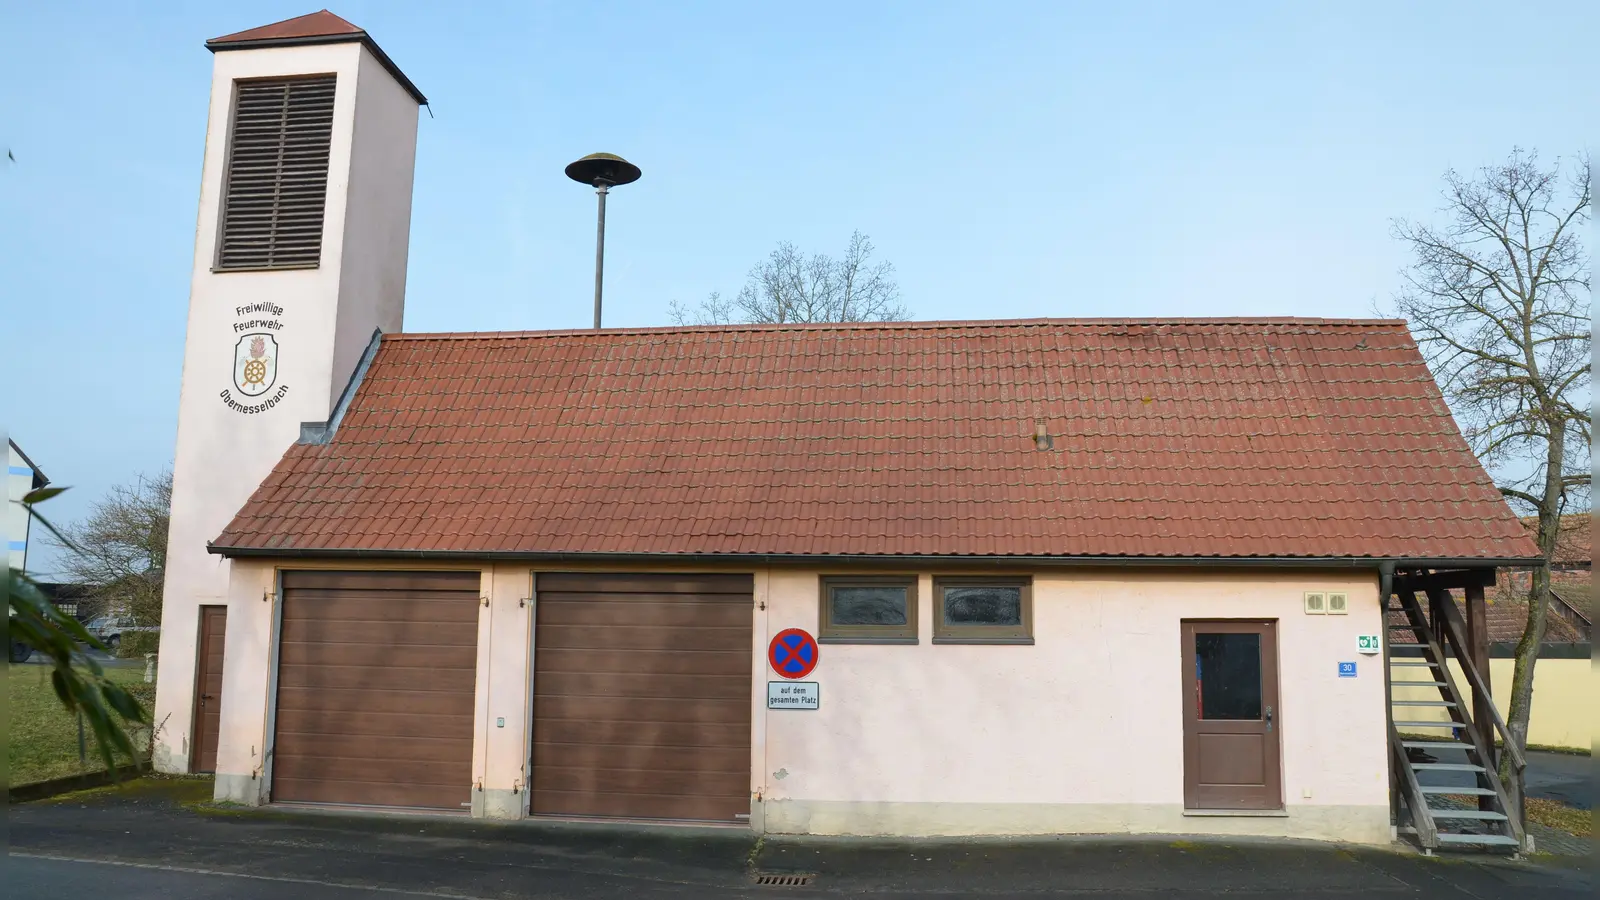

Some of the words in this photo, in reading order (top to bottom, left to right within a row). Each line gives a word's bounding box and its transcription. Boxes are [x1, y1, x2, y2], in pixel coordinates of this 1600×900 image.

[236, 301, 284, 316] Freiwillige
[233, 319, 284, 333] Feuerwehr
[220, 384, 289, 414] Obernesselbach
[1343, 663, 1352, 671] 30
[770, 696, 799, 705] gesamten
[801, 696, 816, 704] Platz
